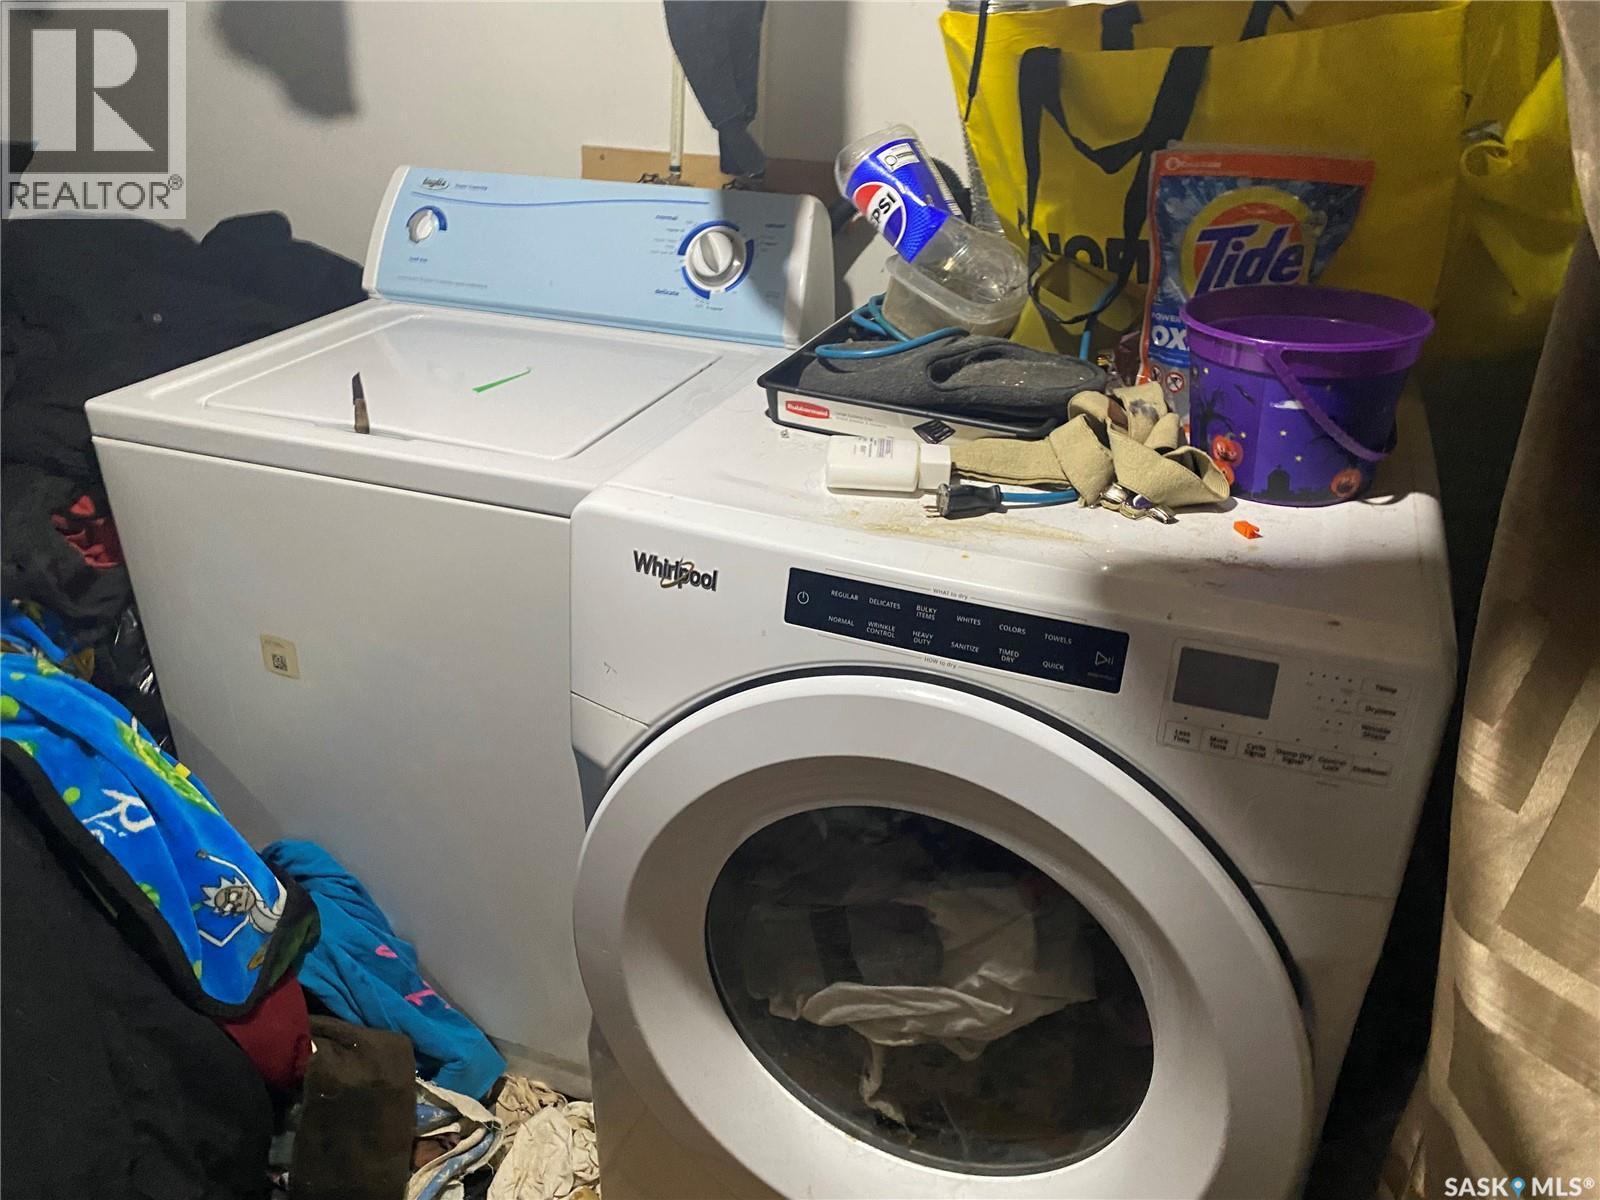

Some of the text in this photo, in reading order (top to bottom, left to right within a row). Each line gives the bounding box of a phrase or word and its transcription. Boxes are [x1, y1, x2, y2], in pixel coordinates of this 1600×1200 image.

[867, 192, 897, 230] PSI
[1196, 224, 1305, 299] Tide
[786, 403, 829, 417] Rubbermaid
[633, 550, 718, 592] Whirlpool
[831, 590, 859, 600] REGULAR
[932, 588, 950, 596] WHAT
[869, 598, 901, 610] DELICATES
[916, 605, 937, 614] BULKY
[828, 616, 855, 626] NORMAL
[916, 612, 936, 620] ITEMS
[956, 615, 981, 626] WHITES
[868, 621, 895, 632] WRINKLE
[999, 624, 1026, 635] COLORS
[866, 627, 896, 639] CONTROL
[912, 630, 934, 639] HEAVY
[1044, 633, 1072, 645] TOWELS
[951, 641, 980, 653] SANITIZE
[999, 648, 1020, 658] TIMED
[1001, 655, 1015, 664] DRY
[1042, 660, 1065, 671] QUICK
